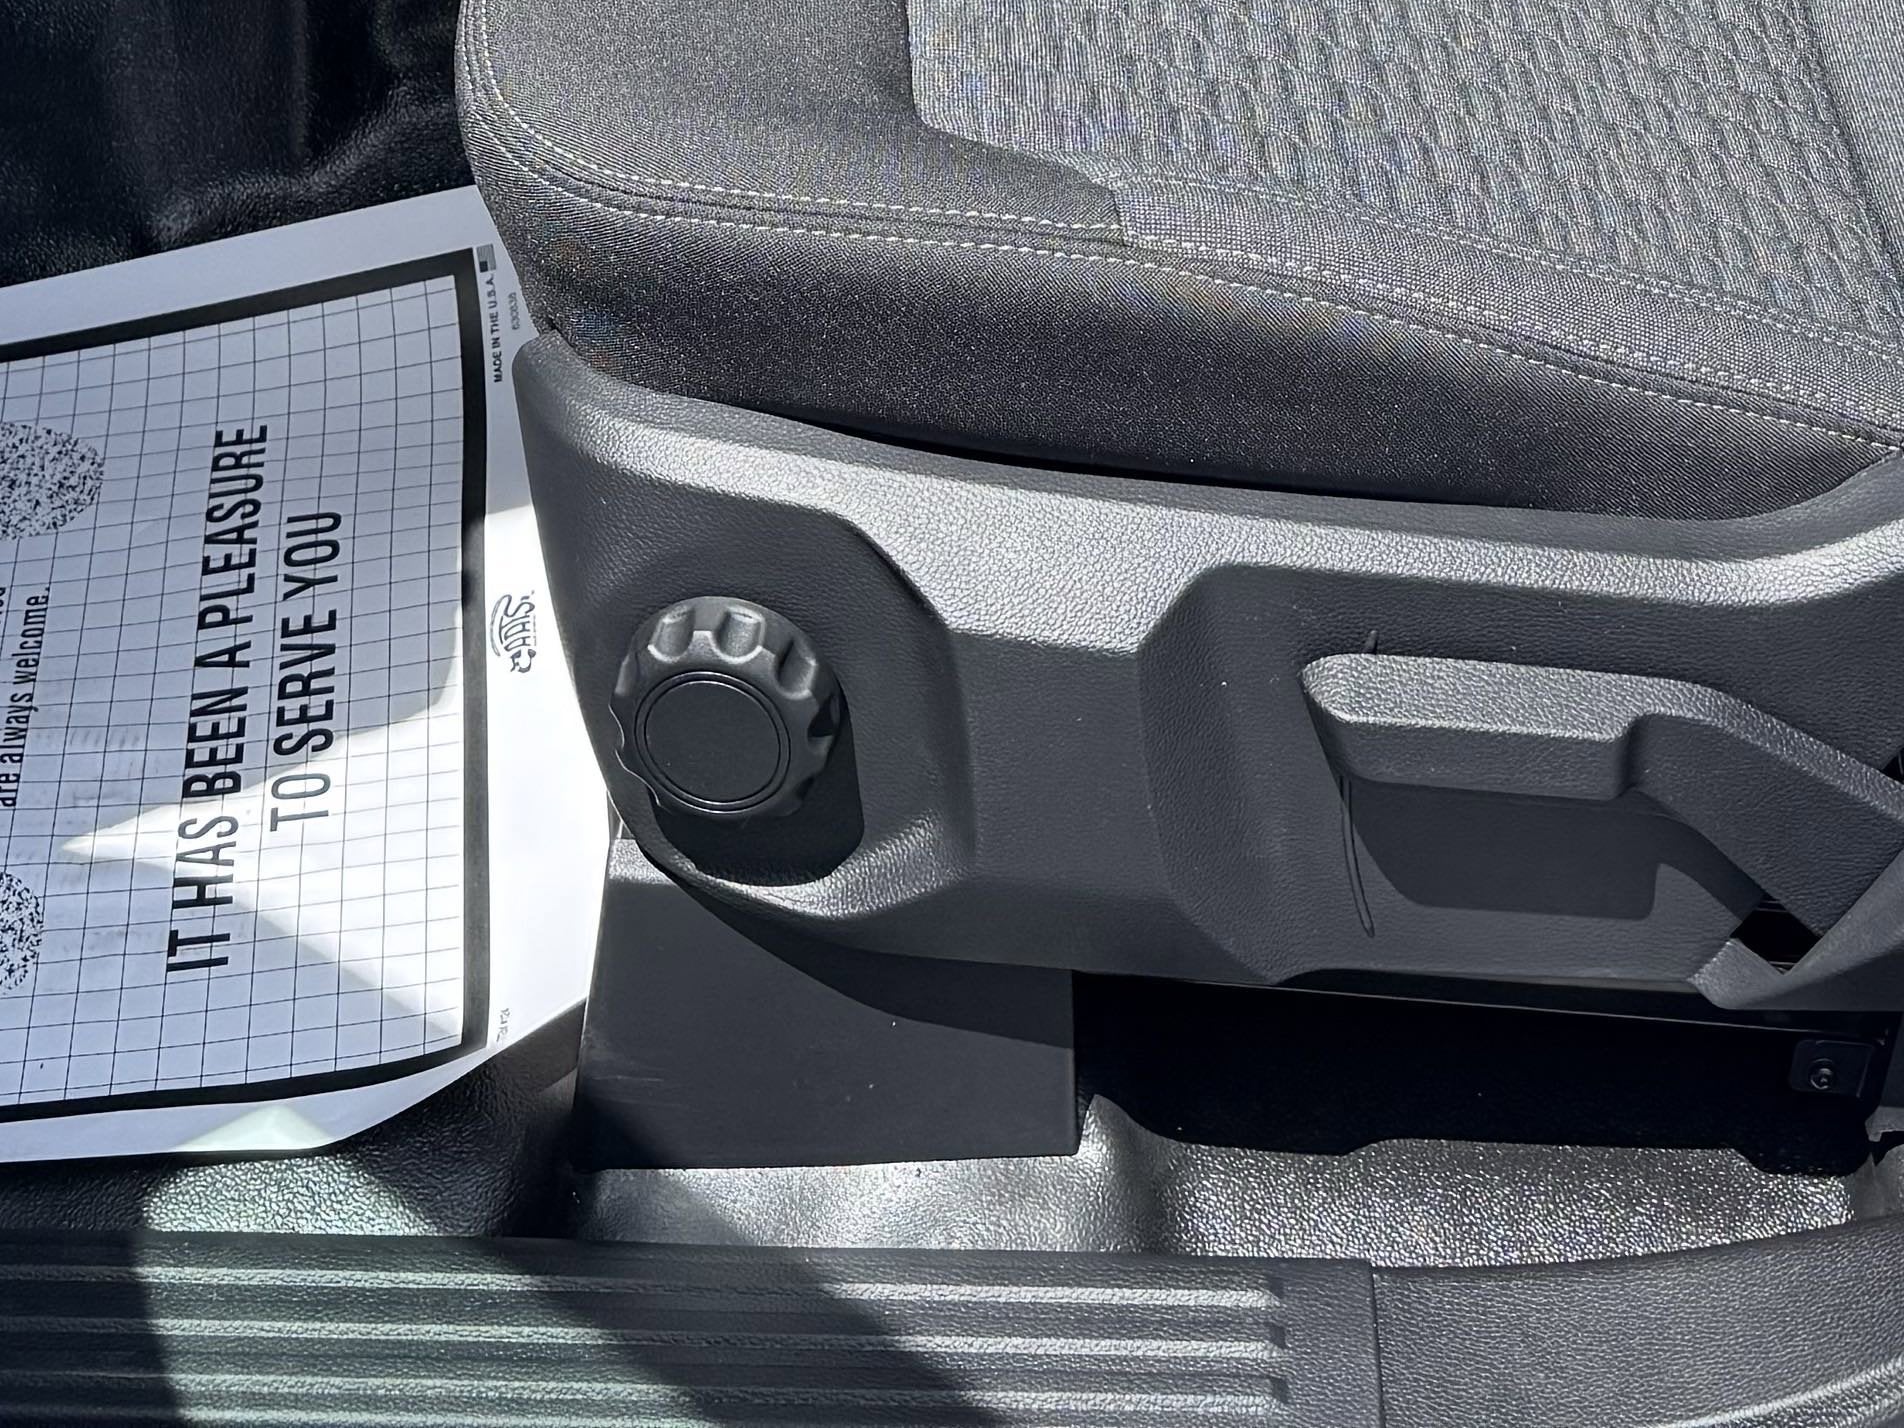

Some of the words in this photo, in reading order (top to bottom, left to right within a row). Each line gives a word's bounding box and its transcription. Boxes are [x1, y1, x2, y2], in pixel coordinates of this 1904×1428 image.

[489, 311, 500, 333] THE
[195, 422, 270, 632] PLEASURE
[282, 510, 345, 603] YOU
[11, 586, 52, 687] welcome.
[194, 639, 254, 671] A
[272, 608, 339, 756] SERVE
[181, 684, 251, 801] BEEN
[269, 770, 334, 834] TO
[171, 813, 241, 912] HAS
[166, 928, 233, 973] IT
